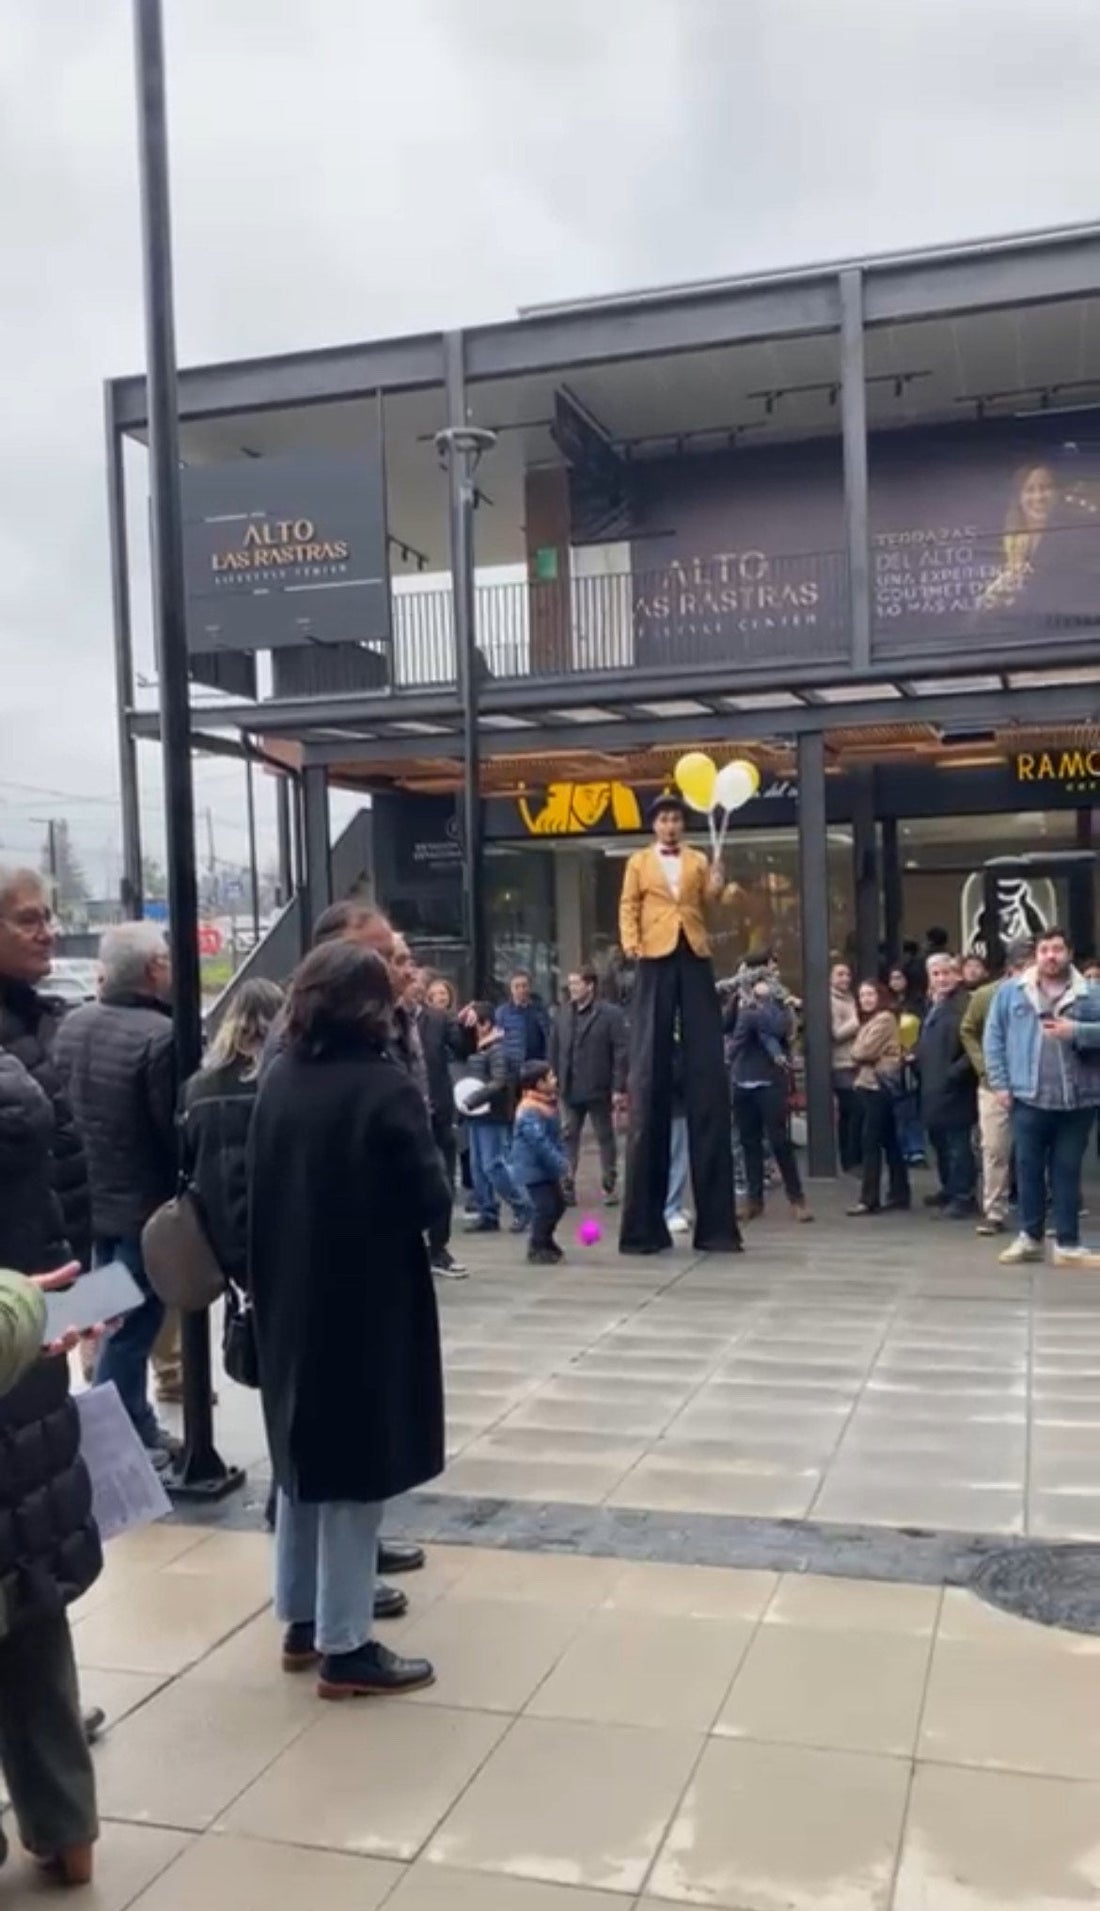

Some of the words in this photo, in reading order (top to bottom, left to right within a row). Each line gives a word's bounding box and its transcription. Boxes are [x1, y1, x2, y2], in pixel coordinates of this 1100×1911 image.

[243, 519, 313, 547] ALTO
[212, 552, 249, 570] LAS
[253, 541, 348, 567] RASTRAS
[662, 551, 769, 588] ALTO
[918, 546, 973, 567] ALTO
[633, 596, 670, 618] AS
[680, 582, 819, 615] RASTRAS
